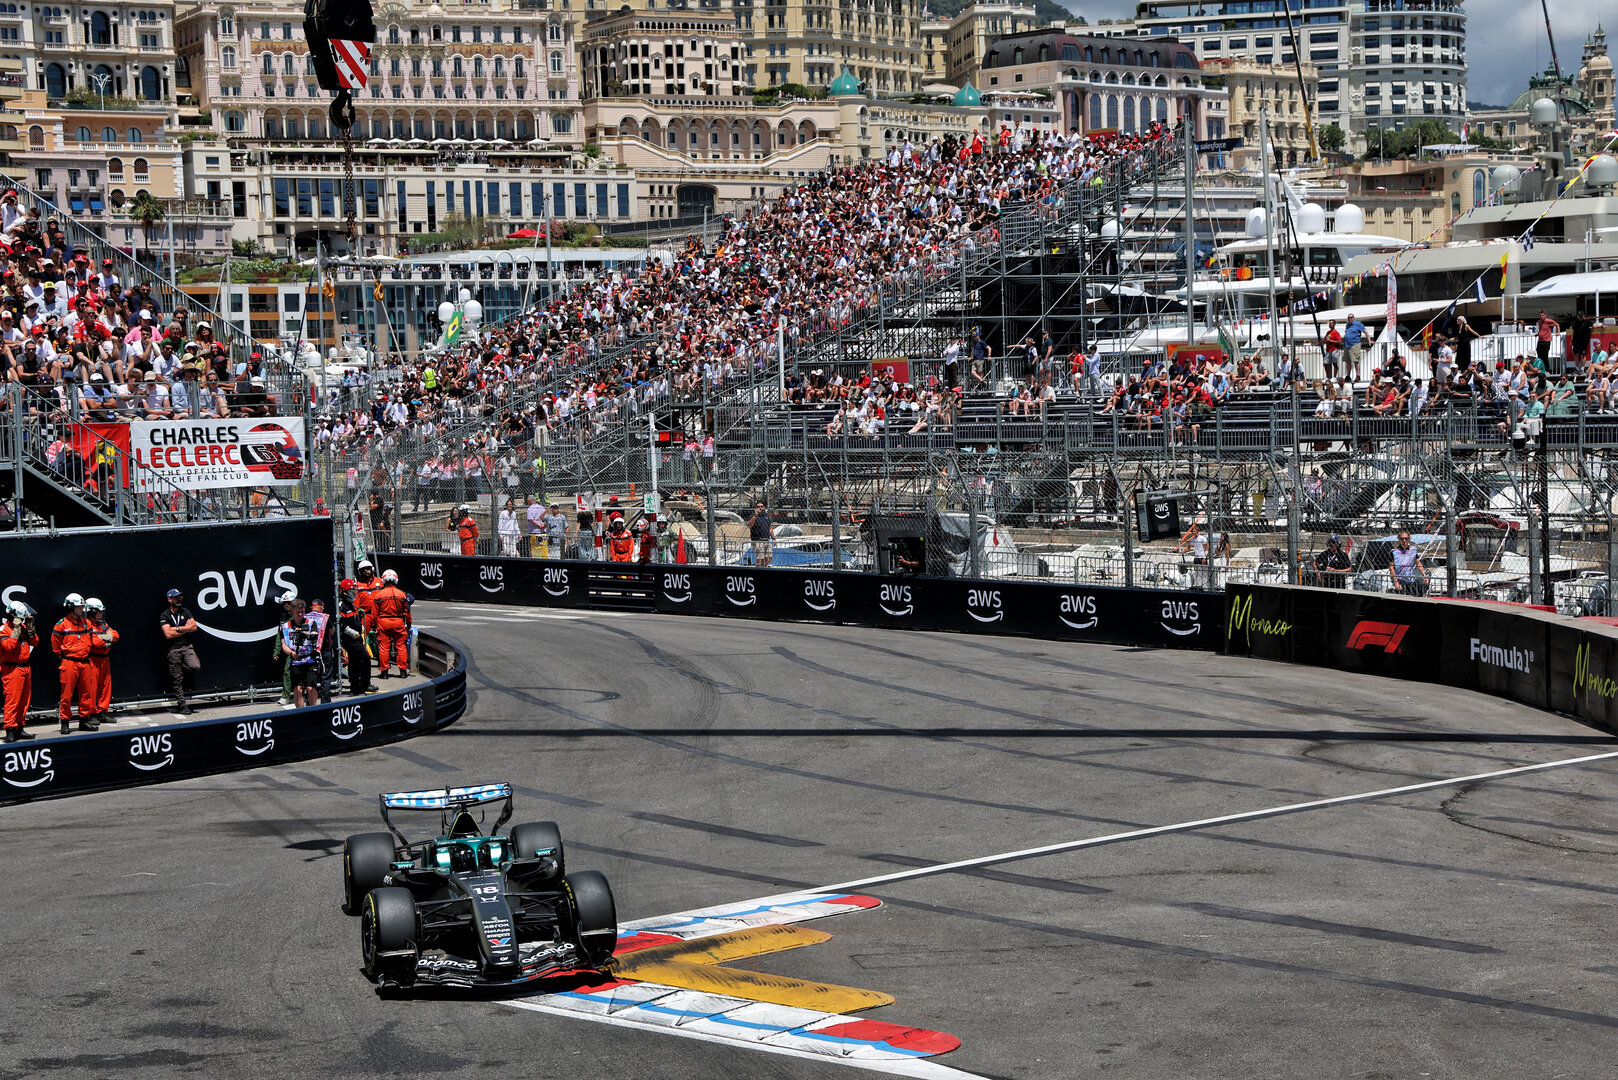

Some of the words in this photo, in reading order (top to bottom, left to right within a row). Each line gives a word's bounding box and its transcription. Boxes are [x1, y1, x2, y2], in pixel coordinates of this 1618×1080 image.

[1200, 142, 1227, 151] salesforce
[150, 426, 239, 446] CHARLES
[136, 444, 240, 468] LECLERC
[147, 476, 192, 485] MARCHE
[223, 472, 249, 480] CLUB
[187, 467, 235, 475] OFFICIAL
[1154, 502, 1169, 513] aws
[420, 562, 443, 577] aws
[479, 565, 503, 581] aws
[543, 568, 568, 584] aws
[197, 565, 298, 610] aws
[664, 573, 690, 590] aws
[726, 576, 755, 593] aws
[804, 579, 834, 597] aws
[880, 584, 912, 602] aws
[968, 589, 1001, 608] aws
[1060, 594, 1096, 614] aws
[1162, 600, 1199, 621] aws
[1228, 593, 1292, 648] Monaco
[1573, 642, 1618, 709] Monaco
[402, 691, 423, 712] aws
[331, 705, 362, 727] aws
[236, 719, 273, 742] aws
[130, 733, 172, 756] aws
[4, 748, 52, 773] aws
[473, 886, 499, 895] 18
[521, 943, 575, 964] aramco
[418, 959, 477, 969] aramco
